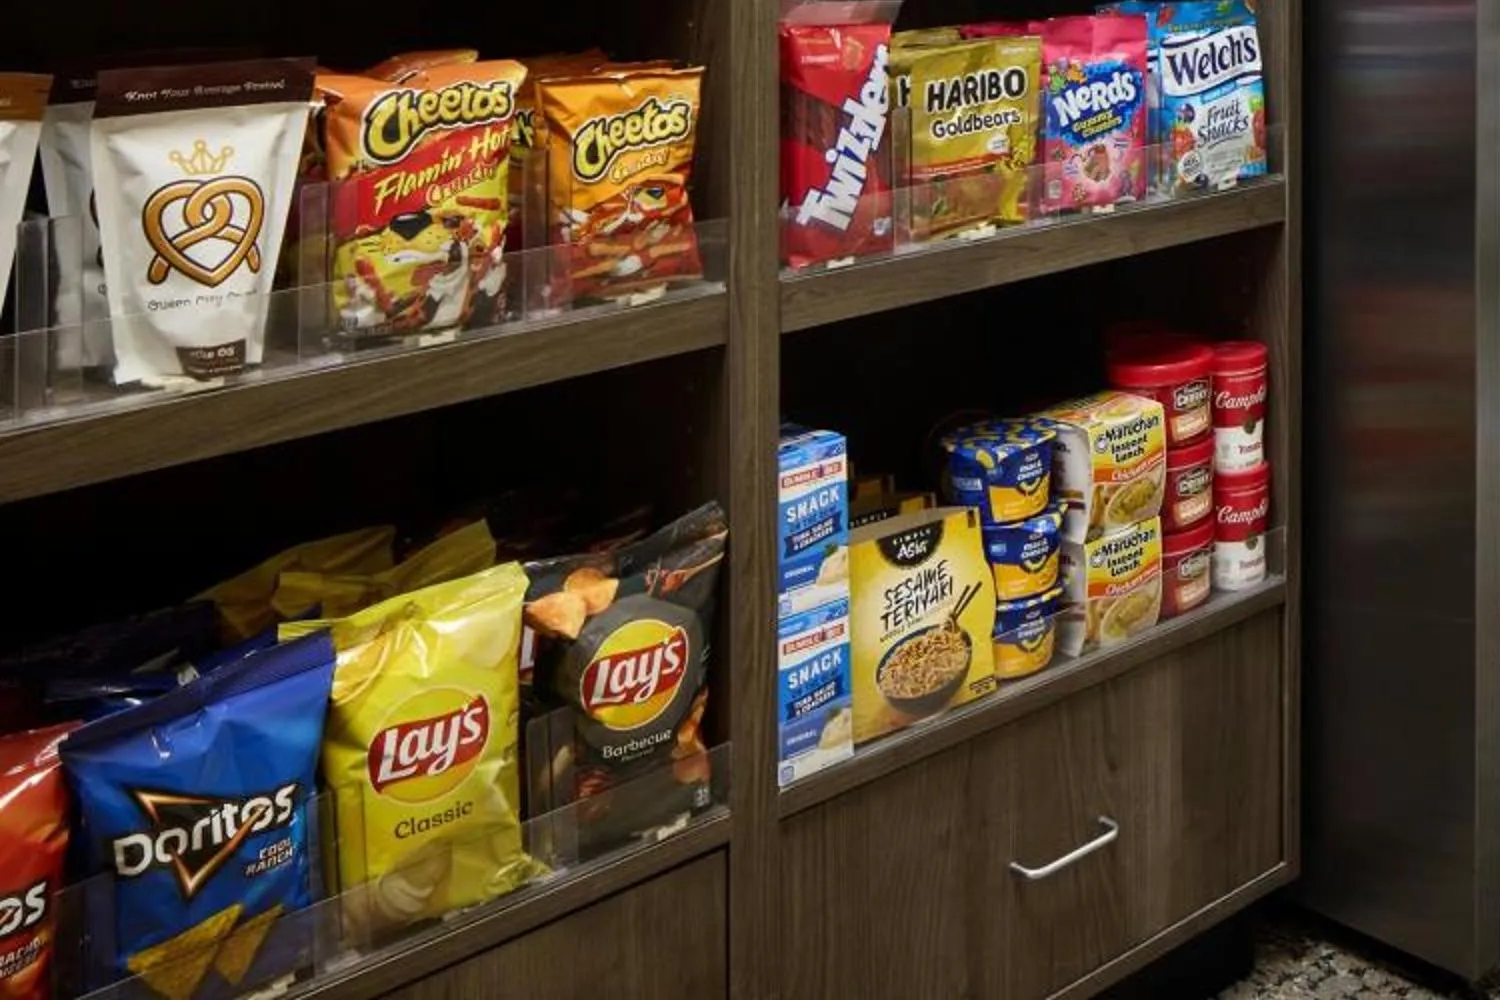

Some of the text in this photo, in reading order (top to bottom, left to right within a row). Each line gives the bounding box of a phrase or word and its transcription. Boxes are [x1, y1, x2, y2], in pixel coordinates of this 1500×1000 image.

[1166, 31, 1257, 85] Welch's
[927, 68, 1026, 113] HARIBO
[366, 81, 513, 159] Cheetos
[931, 108, 1021, 138] Goldbears
[1207, 99, 1241, 126] Fruit
[468, 125, 512, 161] Hot
[573, 98, 690, 179] Cheetos
[609, 146, 670, 184] Crchy
[1215, 383, 1265, 409] Campb
[1106, 415, 1160, 442] Maruchan
[786, 486, 840, 523] SNACK
[1102, 528, 1155, 556] Maruchan
[880, 576, 954, 631] TERIYAKI
[884, 560, 948, 610] SESAME
[592, 634, 685, 708] Lay's
[788, 647, 843, 689] SNACK
[377, 699, 485, 784] Lay's
[603, 728, 673, 760] Barbecue
[113, 784, 297, 876] Doritos
[394, 799, 474, 839] Classic
